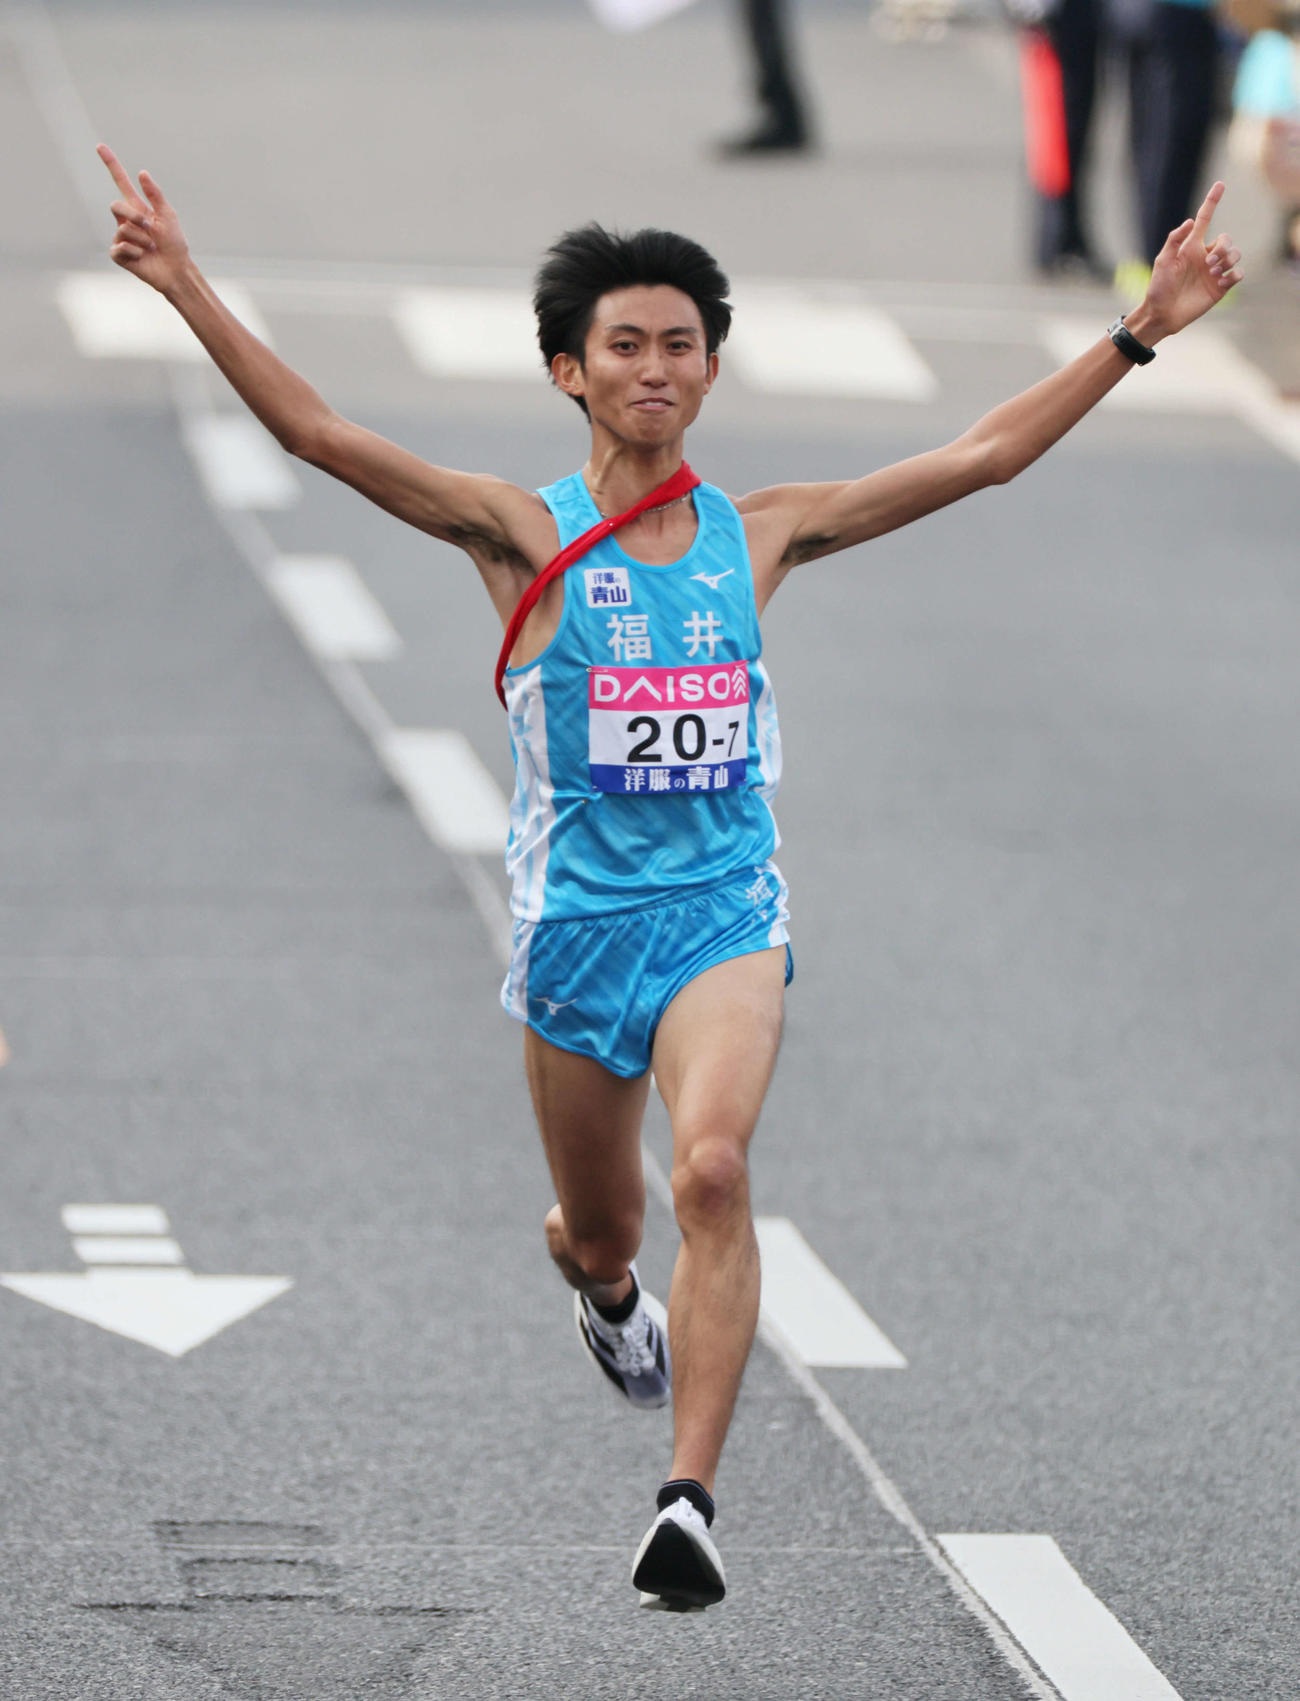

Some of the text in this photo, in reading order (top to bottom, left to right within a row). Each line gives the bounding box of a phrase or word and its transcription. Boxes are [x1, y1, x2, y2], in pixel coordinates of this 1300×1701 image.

[592, 586, 627, 604] 青山
[606, 611, 723, 661] 福井
[594, 672, 730, 703] DAISO
[627, 714, 739, 762] 20-7
[624, 765, 729, 791] 洋服の青山
